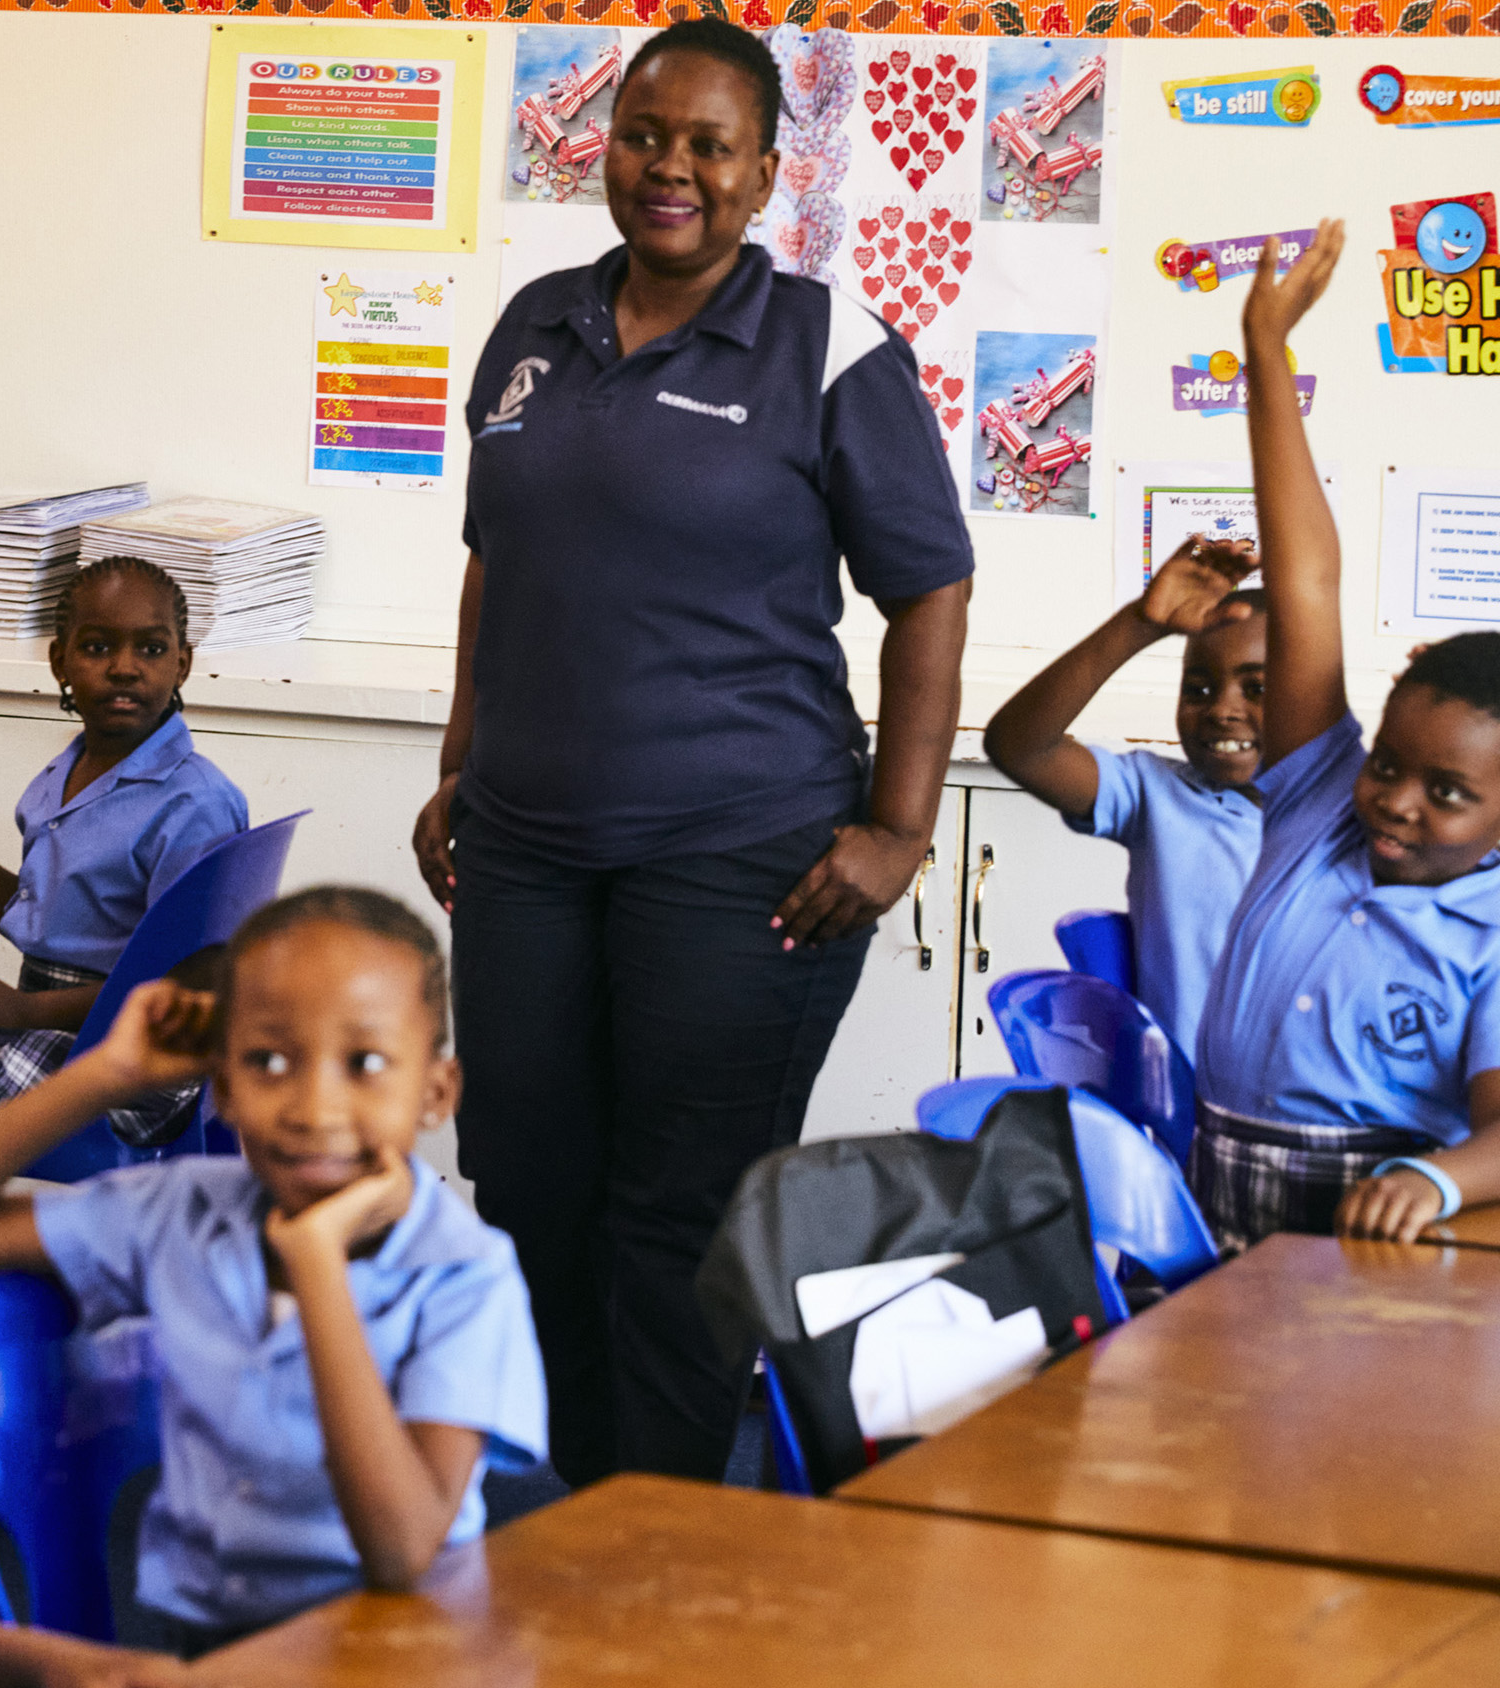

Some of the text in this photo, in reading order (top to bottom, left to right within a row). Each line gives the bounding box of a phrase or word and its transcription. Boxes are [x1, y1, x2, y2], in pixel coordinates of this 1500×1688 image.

[255, 64, 433, 82] OUR RULES
[278, 86, 408, 100] Always do your best.
[1403, 89, 1457, 106] cover
[285, 103, 399, 116] Share with others.
[1194, 90, 1267, 115] be still
[291, 120, 390, 132] Use kind words.
[267, 135, 414, 149] Listen when others talk.
[268, 151, 303, 161] Clean
[307, 154, 324, 163] up
[327, 154, 351, 163] and
[355, 156, 383, 165] help
[256, 167, 421, 184] Say please and thank you.
[276, 185, 400, 199] Respect each other.
[284, 202, 390, 215] Follow directions.
[1393, 267, 1472, 319] Use
[362, 310, 398, 322] VIRTUES
[1446, 325, 1500, 375] Ha
[1180, 378, 1233, 402] offer
[1169, 496, 1189, 506] We
[1192, 497, 1222, 506] take
